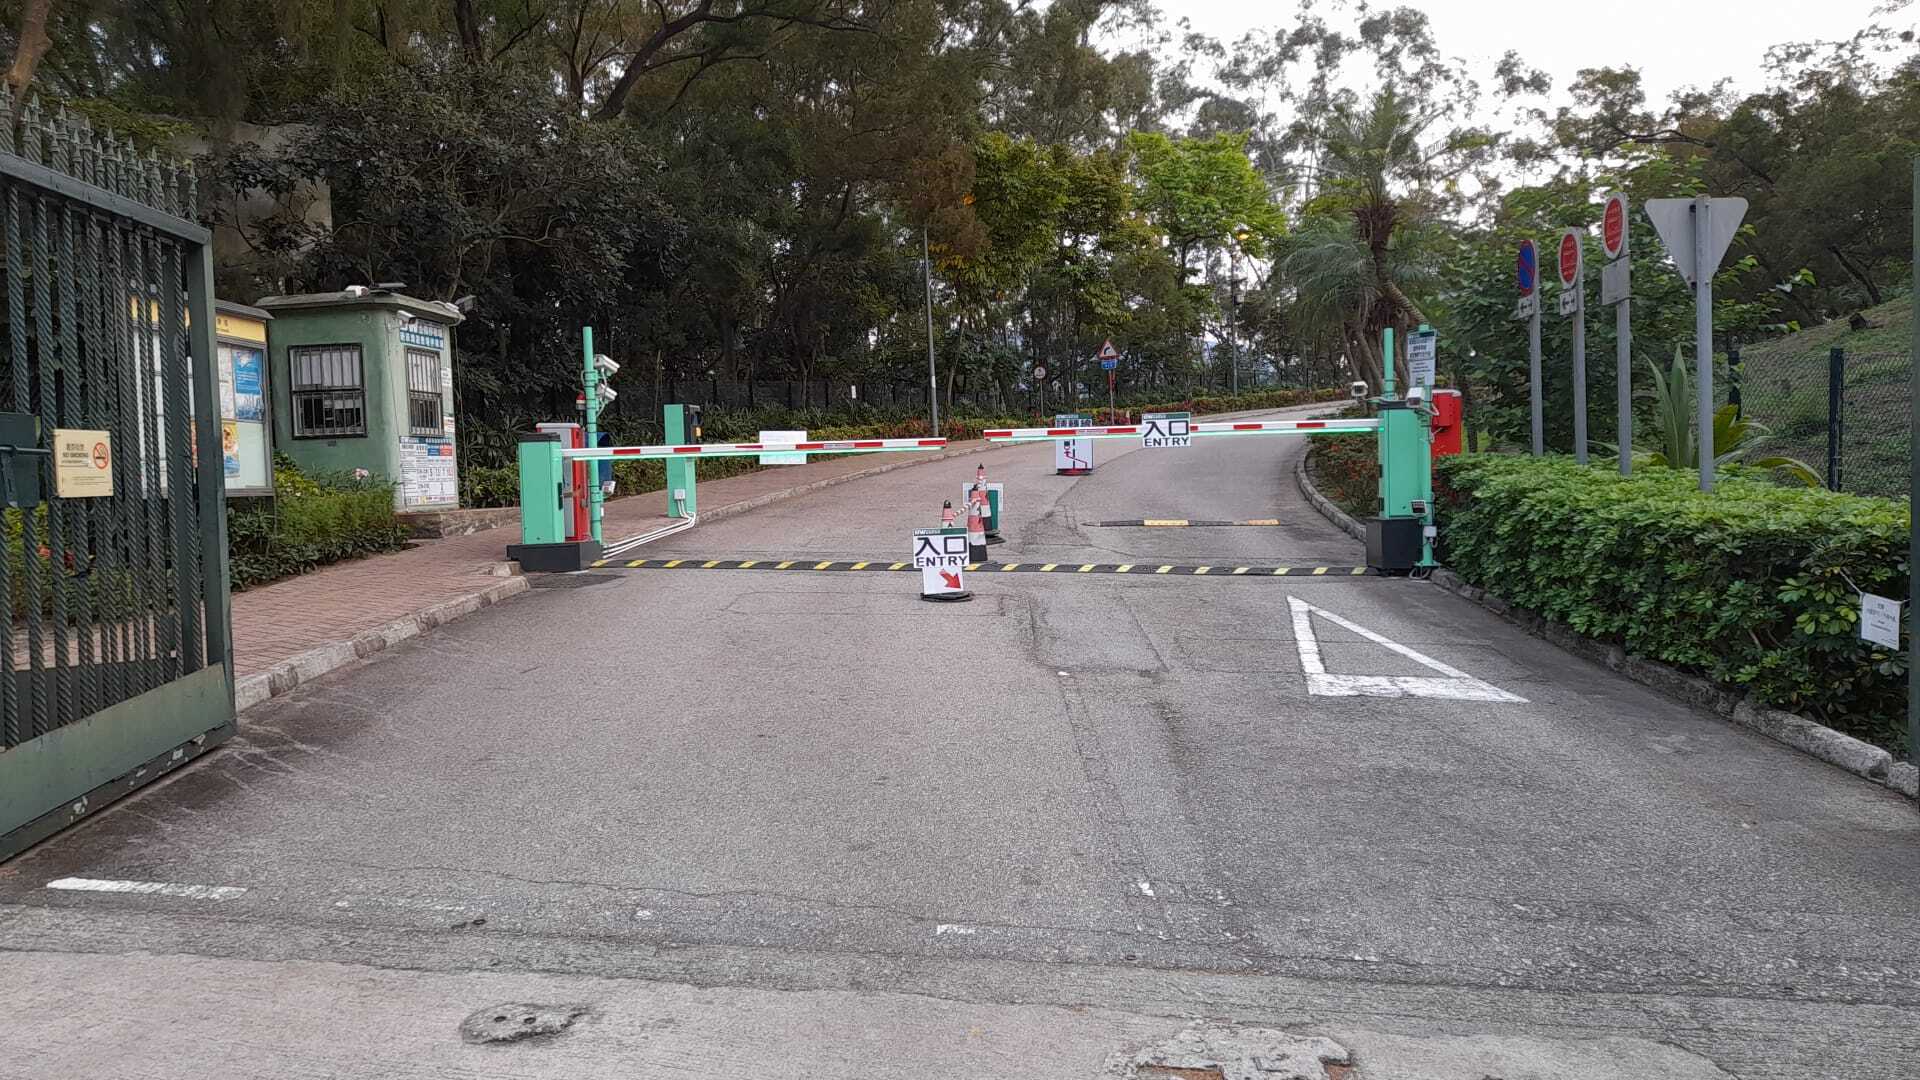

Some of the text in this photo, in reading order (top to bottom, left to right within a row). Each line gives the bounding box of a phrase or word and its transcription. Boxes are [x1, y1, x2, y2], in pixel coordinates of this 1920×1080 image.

[1143, 420, 1189, 438] 入口
[1144, 437, 1190, 447] ENTRY
[914, 535, 968, 557] 入口
[915, 555, 968, 567] ENTRY
